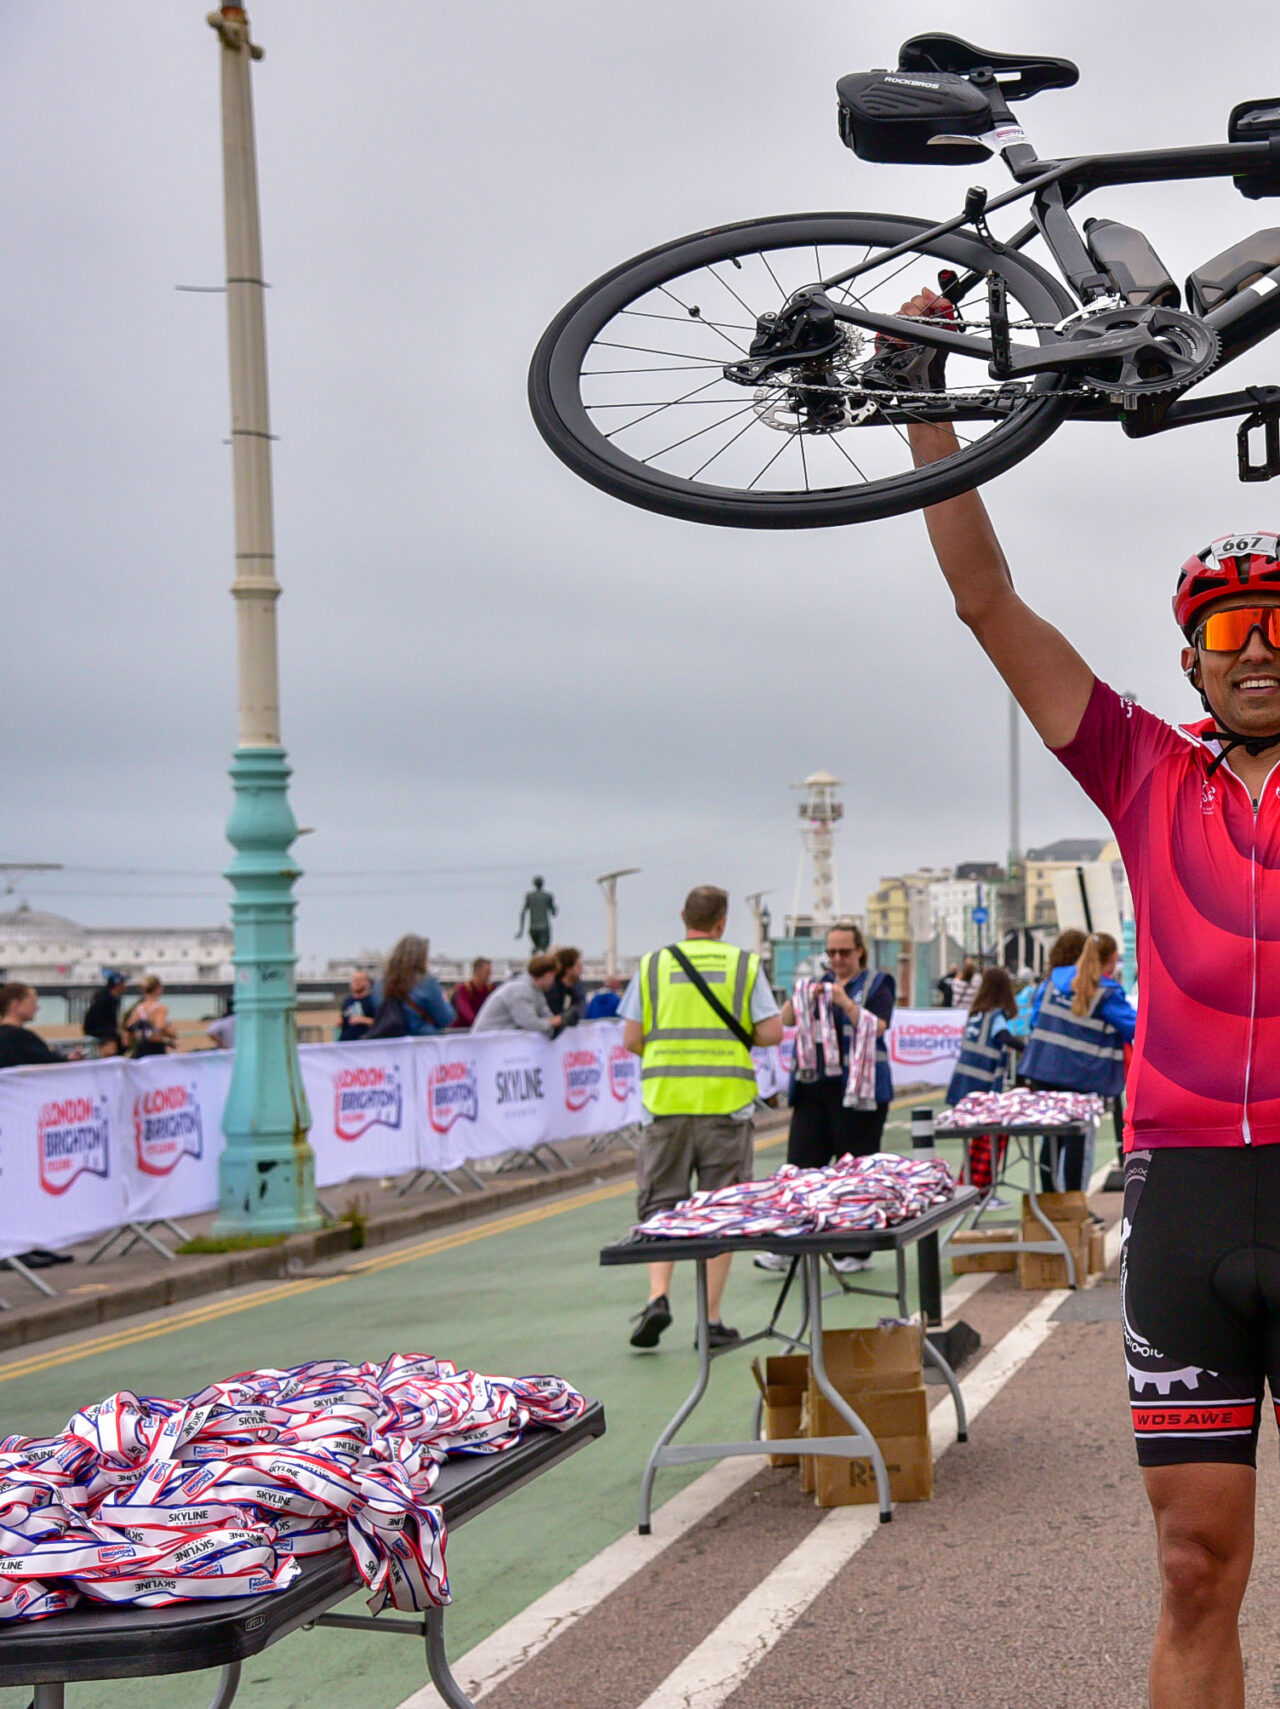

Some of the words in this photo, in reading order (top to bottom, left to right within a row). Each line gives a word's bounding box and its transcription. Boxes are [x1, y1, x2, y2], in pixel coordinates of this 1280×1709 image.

[884, 76, 940, 90] ROCKBROS
[1222, 536, 1263, 552] 667
[899, 1036, 962, 1048] BRIGHTO
[336, 1066, 386, 1088] LONDON
[497, 1066, 543, 1104] SKYLINE
[341, 1088, 394, 1111] BRIGHTON
[43, 1097, 93, 1127] LONDON
[45, 1125, 100, 1158] BRIGHTON
[313, 1394, 345, 1408] SKYLINE
[183, 1411, 204, 1437] SKYLINE
[239, 1416, 268, 1426] SKYLIN
[1137, 1412, 1233, 1426] WOSAWE
[24, 1449, 55, 1462] KYLINE
[117, 1466, 148, 1482] YLINE
[256, 1490, 291, 1507] SKYLINE
[168, 1510, 208, 1522] SKYLINE
[102, 1549, 131, 1558] BRIGHTON
[175, 1539, 215, 1562] SKYLINE
[0, 1561, 24, 1571] YLINE
[135, 1580, 176, 1592] SKYLINE
